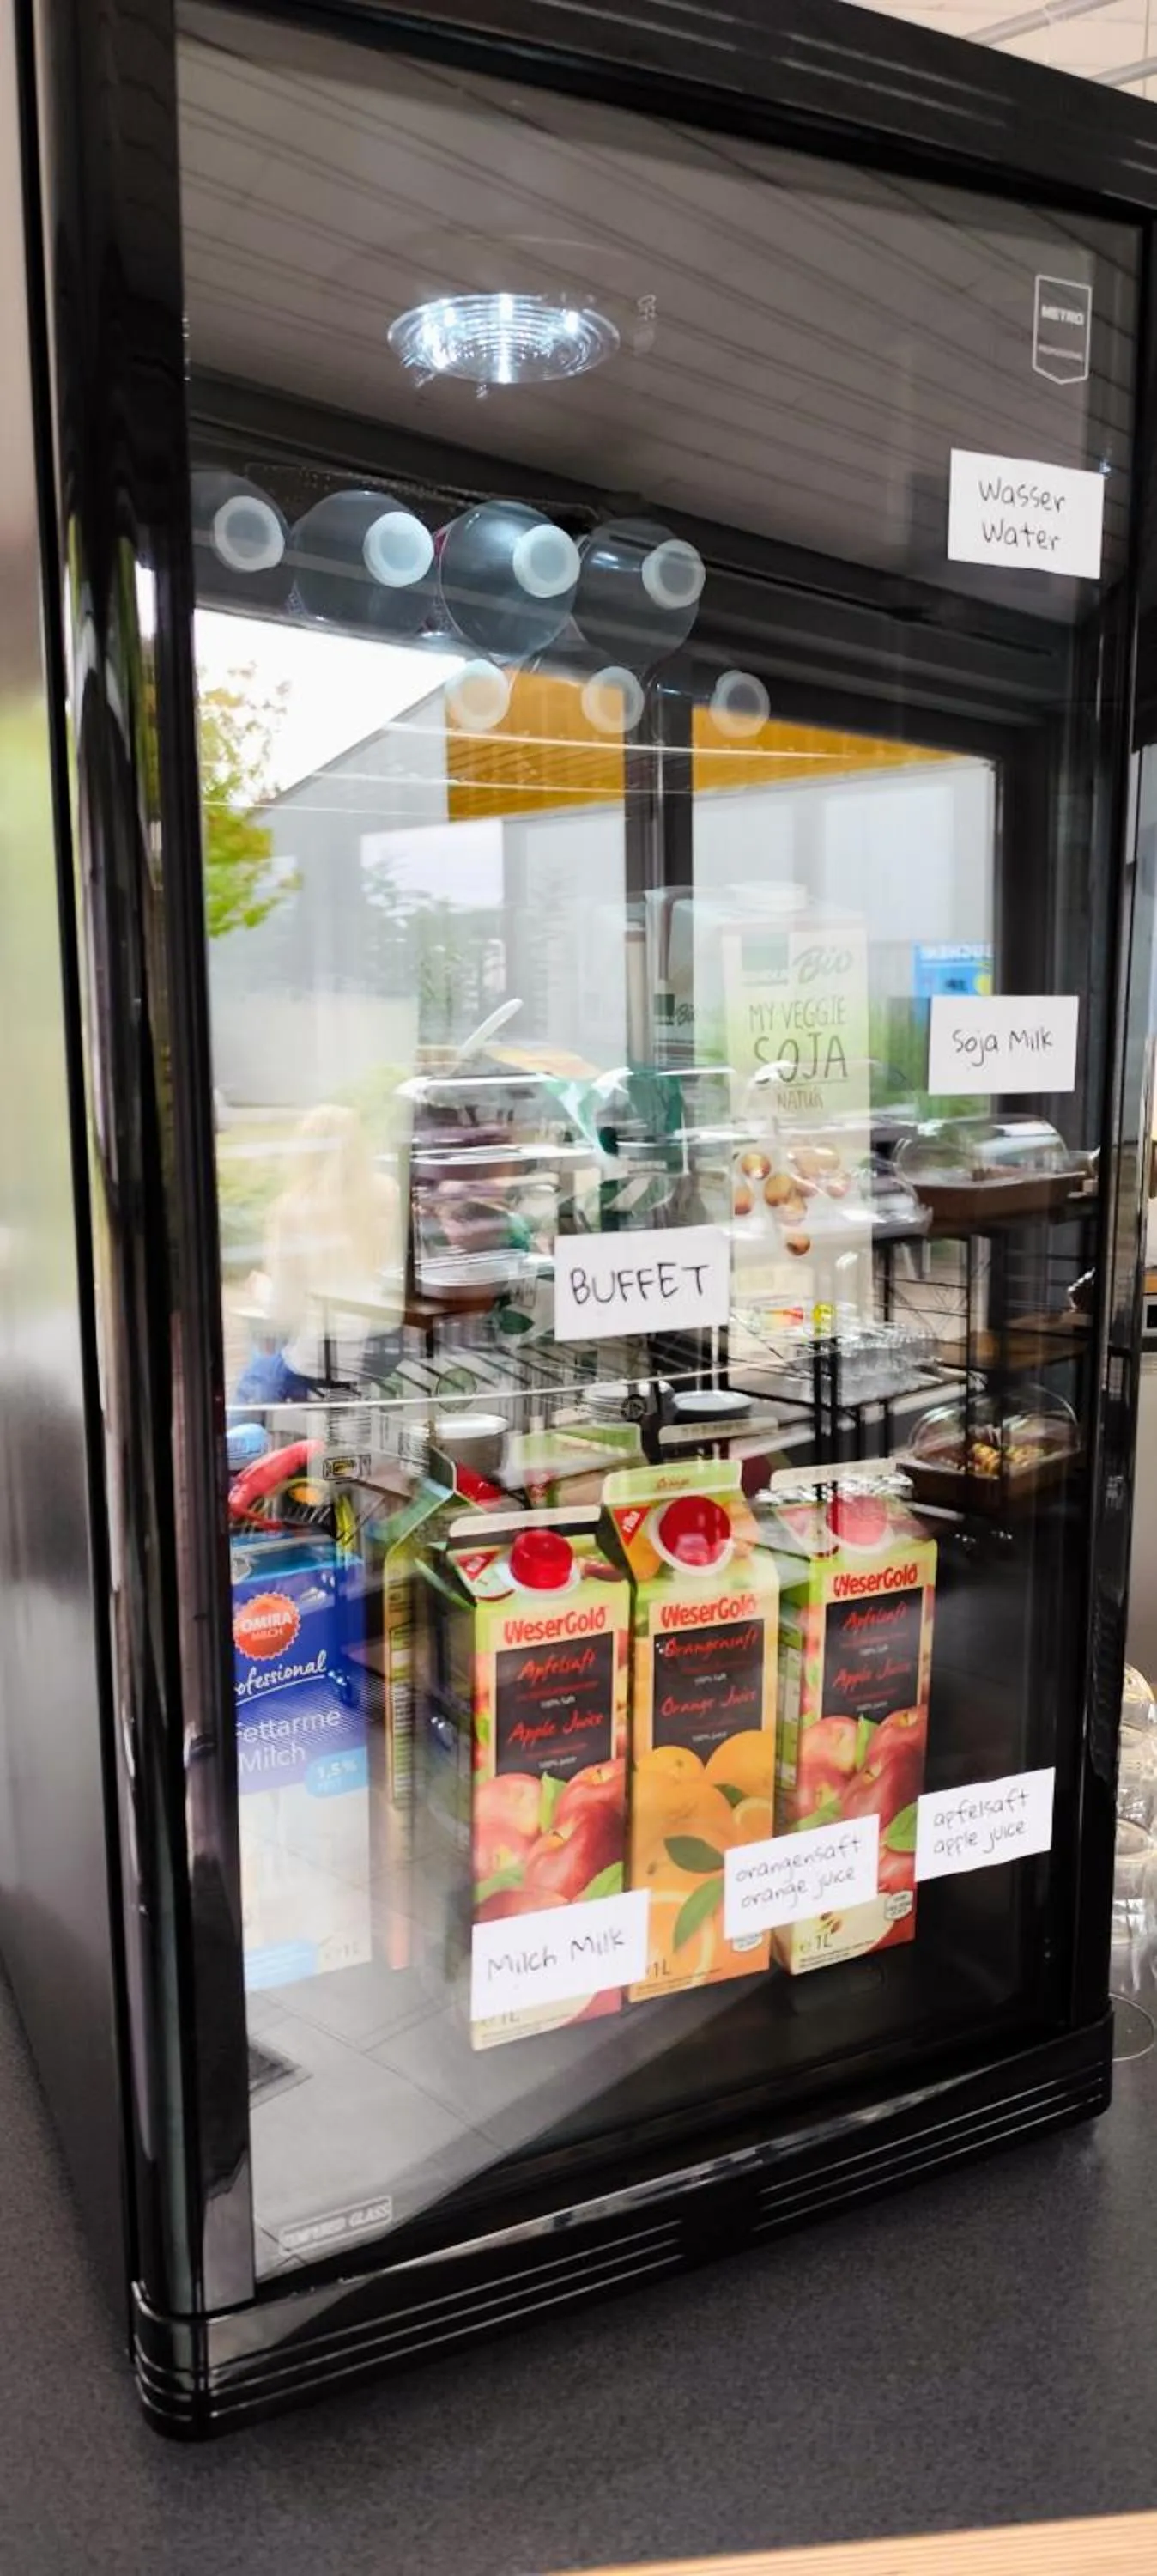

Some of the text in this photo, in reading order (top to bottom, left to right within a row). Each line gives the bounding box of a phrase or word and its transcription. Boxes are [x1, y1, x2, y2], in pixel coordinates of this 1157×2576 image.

[978, 477, 1066, 513] Wasser
[982, 519, 1060, 550] Water
[748, 994, 846, 1032] MY VEGGIE
[754, 1031, 848, 1084] SOJA
[951, 1027, 1053, 1066] Soja Milk
[570, 1262, 709, 1305] BUFFET
[833, 1563, 918, 1598] WeserGold
[239, 1611, 293, 1633] OMIRA
[504, 1606, 607, 1645] WeserGold
[660, 1594, 757, 1629] WeserGold
[235, 1649, 327, 1698] ofessional
[506, 1720, 556, 1751] Apple
[933, 1789, 1030, 1831] apfelsaft
[932, 1820, 1027, 1858] apple juice
[735, 1836, 862, 1885] orangensaft
[741, 1867, 857, 1911] orange juice
[488, 1926, 625, 1981] Milch Milk
